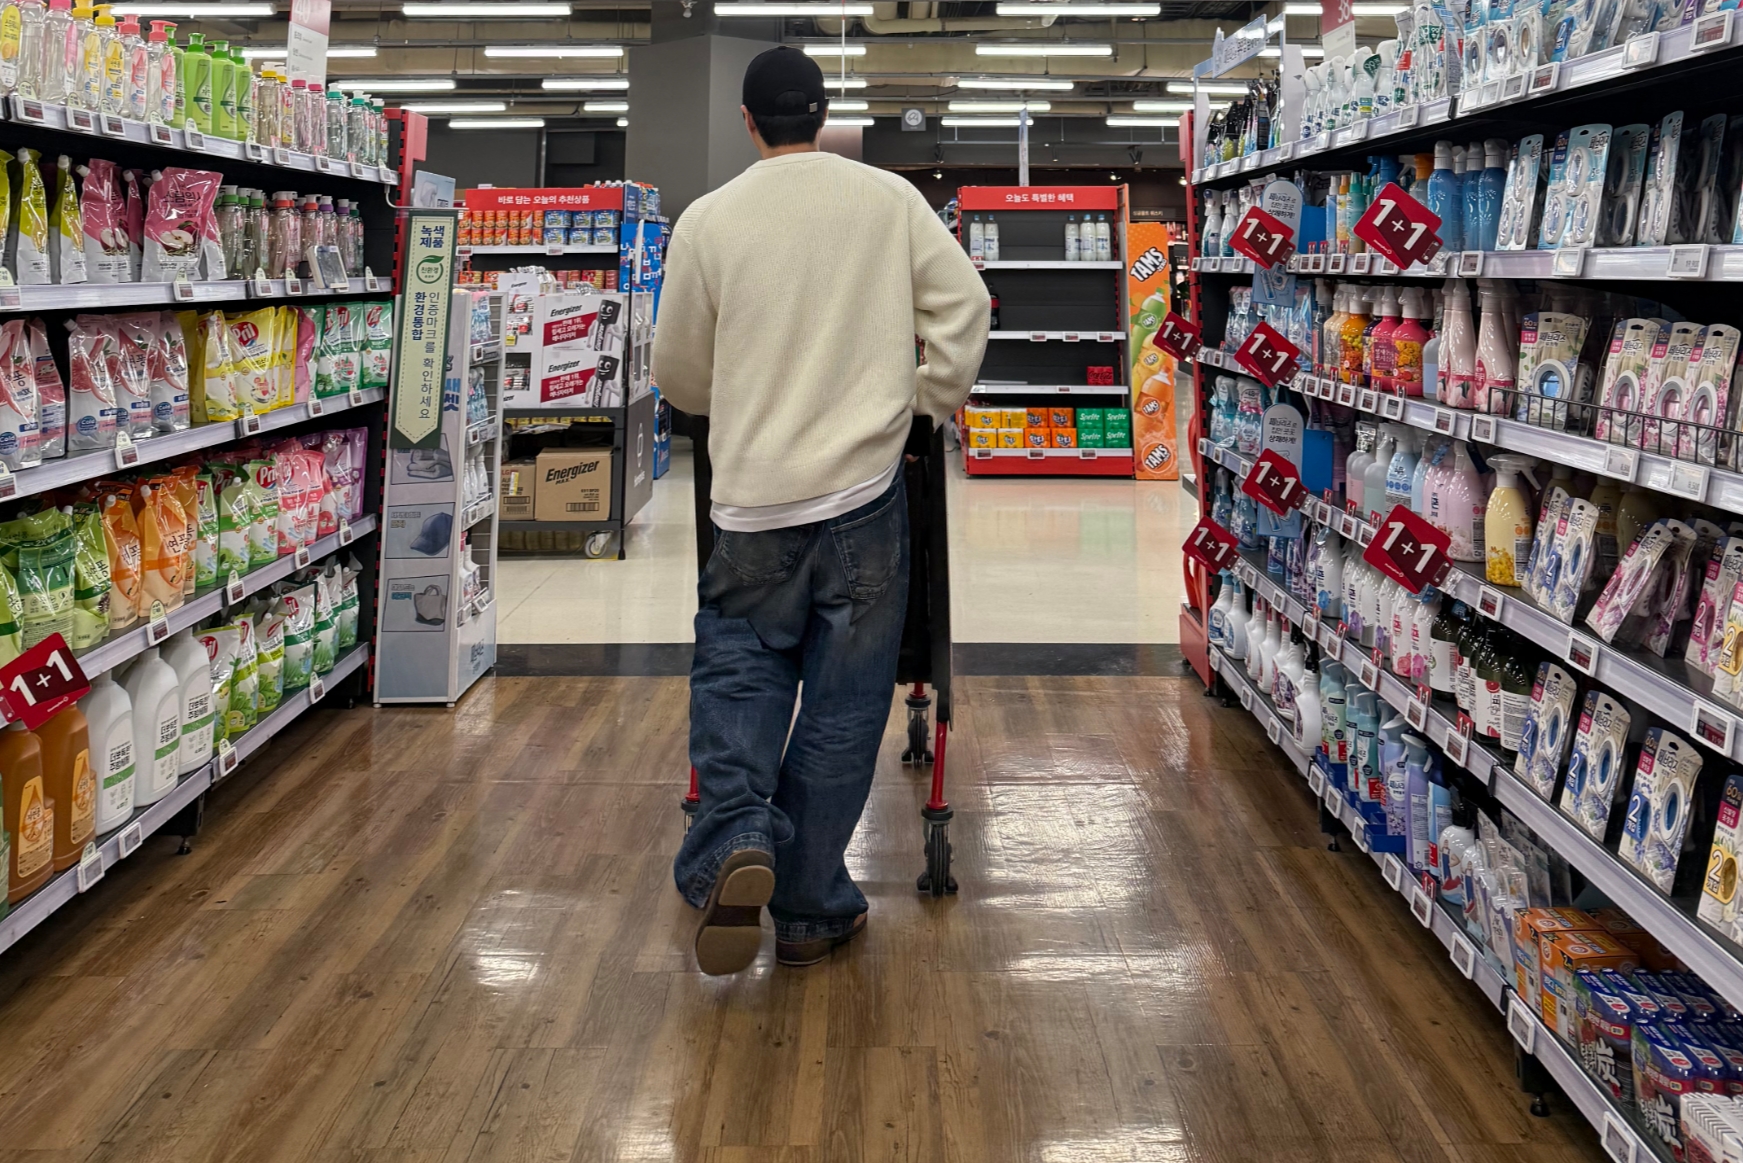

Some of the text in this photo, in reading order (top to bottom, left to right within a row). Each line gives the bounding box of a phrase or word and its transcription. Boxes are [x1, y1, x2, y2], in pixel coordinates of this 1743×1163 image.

[498, 195, 589, 204] 바로 담는 오늘의 추천상품
[1005, 193, 1074, 203] 오늘도 특별한 혜택
[421, 225, 445, 237] 녹색
[1243, 218, 1284, 255] 1+1
[1372, 199, 1428, 251] 1+1
[419, 236, 445, 249] 제품
[421, 266, 439, 274] 친환경
[1130, 246, 1166, 282] TAMS
[424, 292, 440, 354] 인증마크를
[550, 305, 582, 317] Energizer
[231, 323, 256, 341] Pril
[1162, 321, 1193, 350] 1+1
[1539, 331, 1566, 342] 페브리즈
[1248, 333, 1289, 373] 1+1
[548, 360, 580, 373] Energizer
[418, 357, 435, 420] 확인하세요
[1080, 413, 1100, 421] Sprite
[1107, 413, 1126, 421] Sprite
[1106, 431, 1126, 439] Sprite
[1145, 445, 1169, 470] TAMS
[545, 461, 600, 483] Energizer
[1255, 461, 1297, 500] 1+1
[1194, 527, 1230, 562] 1+1
[1382, 522, 1437, 573] 1+1
[1547, 554, 1556, 577] 2
[1695, 601, 1706, 627] 2
[1724, 626, 1735, 655] 2
[10, 649, 73, 706] 1+1
[1522, 720, 1532, 742] 2
[1569, 753, 1580, 779] 2
[1628, 795, 1641, 822] 2
[1708, 850, 1723, 881] 2
